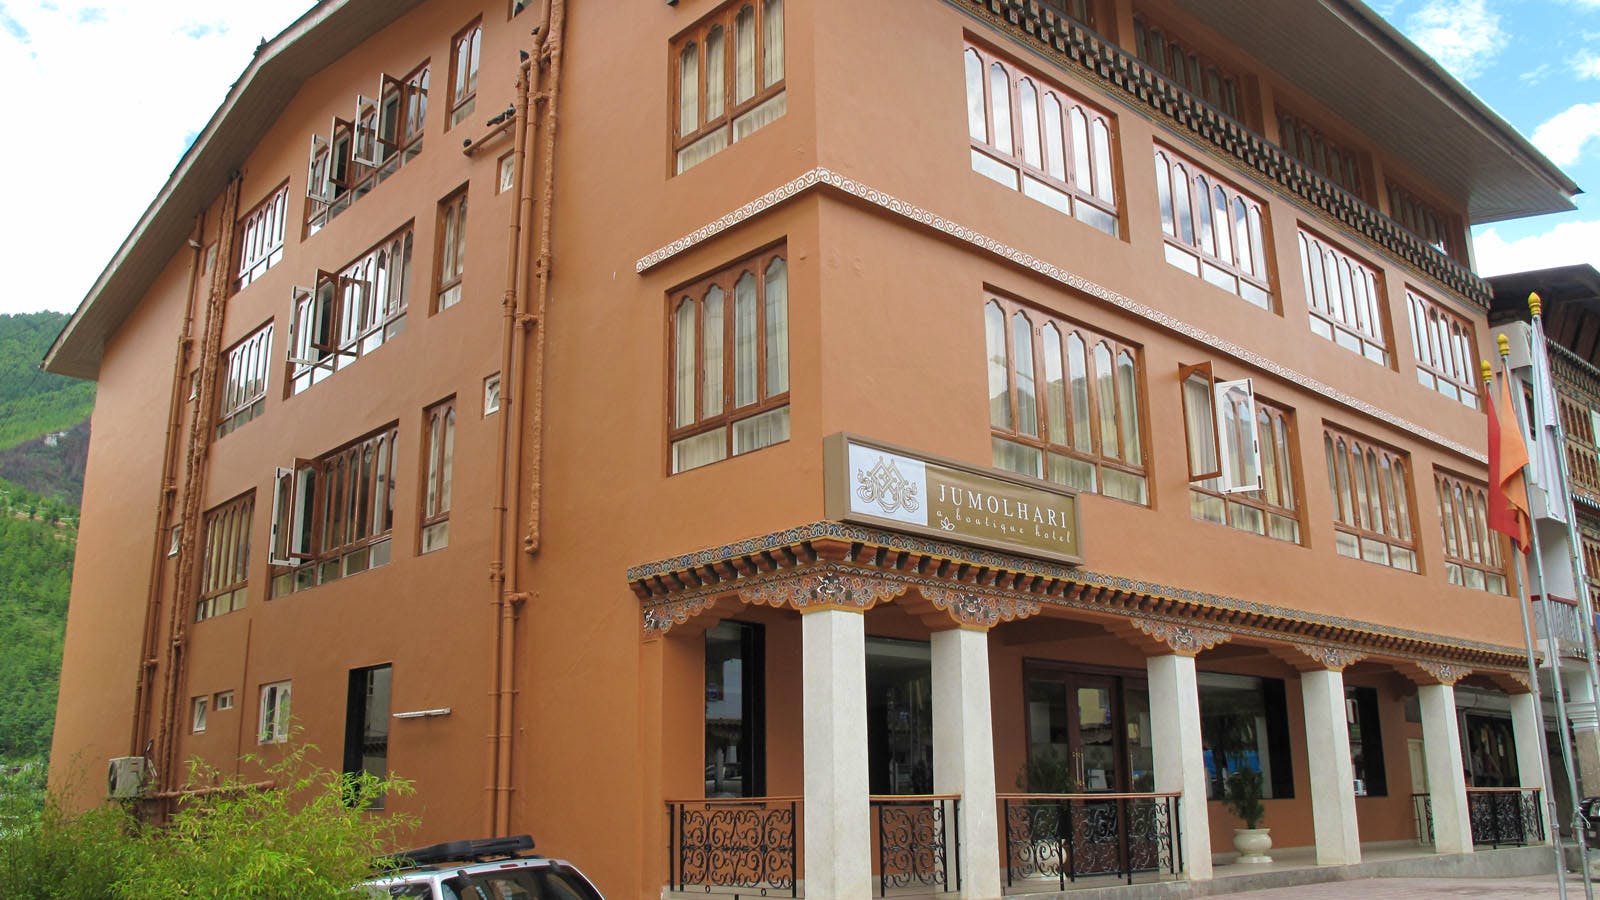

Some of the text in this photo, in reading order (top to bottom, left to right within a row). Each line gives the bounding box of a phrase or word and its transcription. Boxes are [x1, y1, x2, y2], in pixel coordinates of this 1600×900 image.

[938, 484, 1067, 528] JUMOLHARI
[955, 508, 1024, 534] boutique
[1035, 525, 1071, 543] hotel
